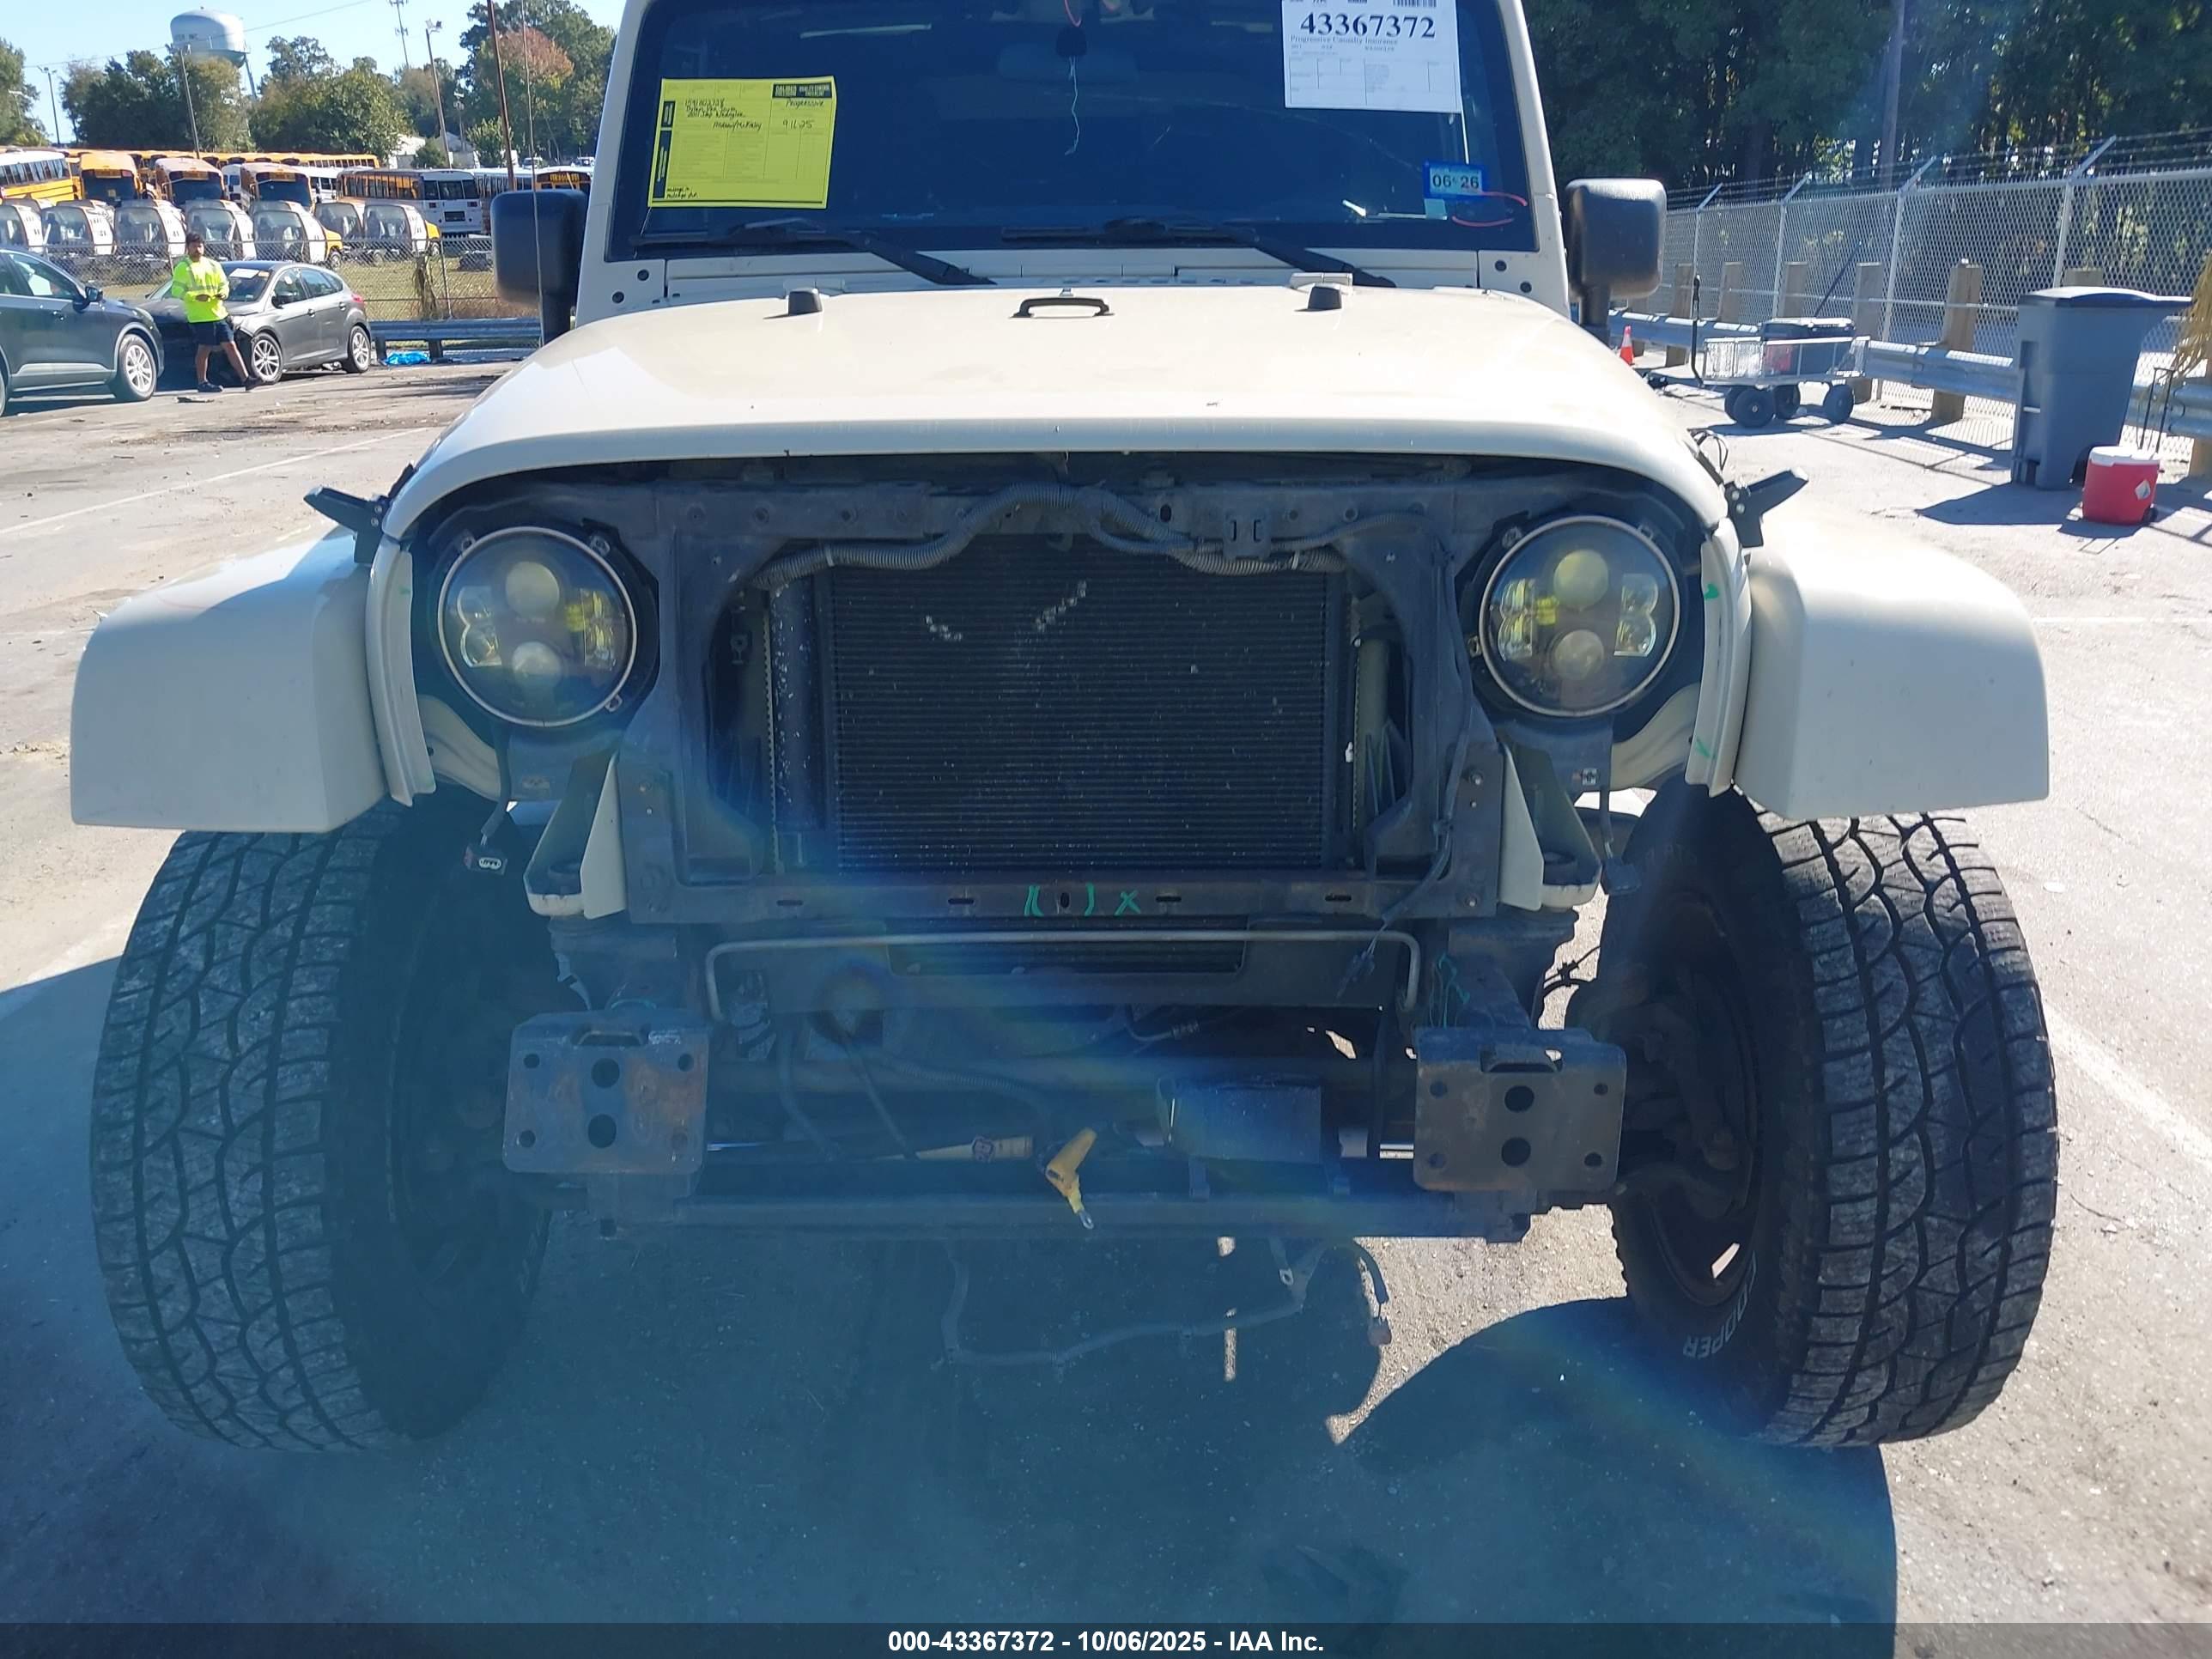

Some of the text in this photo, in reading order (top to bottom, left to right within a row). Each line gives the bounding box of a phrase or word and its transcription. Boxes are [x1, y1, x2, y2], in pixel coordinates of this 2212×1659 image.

[1300, 11, 1436, 38] 43367372
[1291, 34, 1331, 45] Progressive
[1364, 36, 1398, 46] Insurance
[1432, 174, 1480, 189] 06 26
